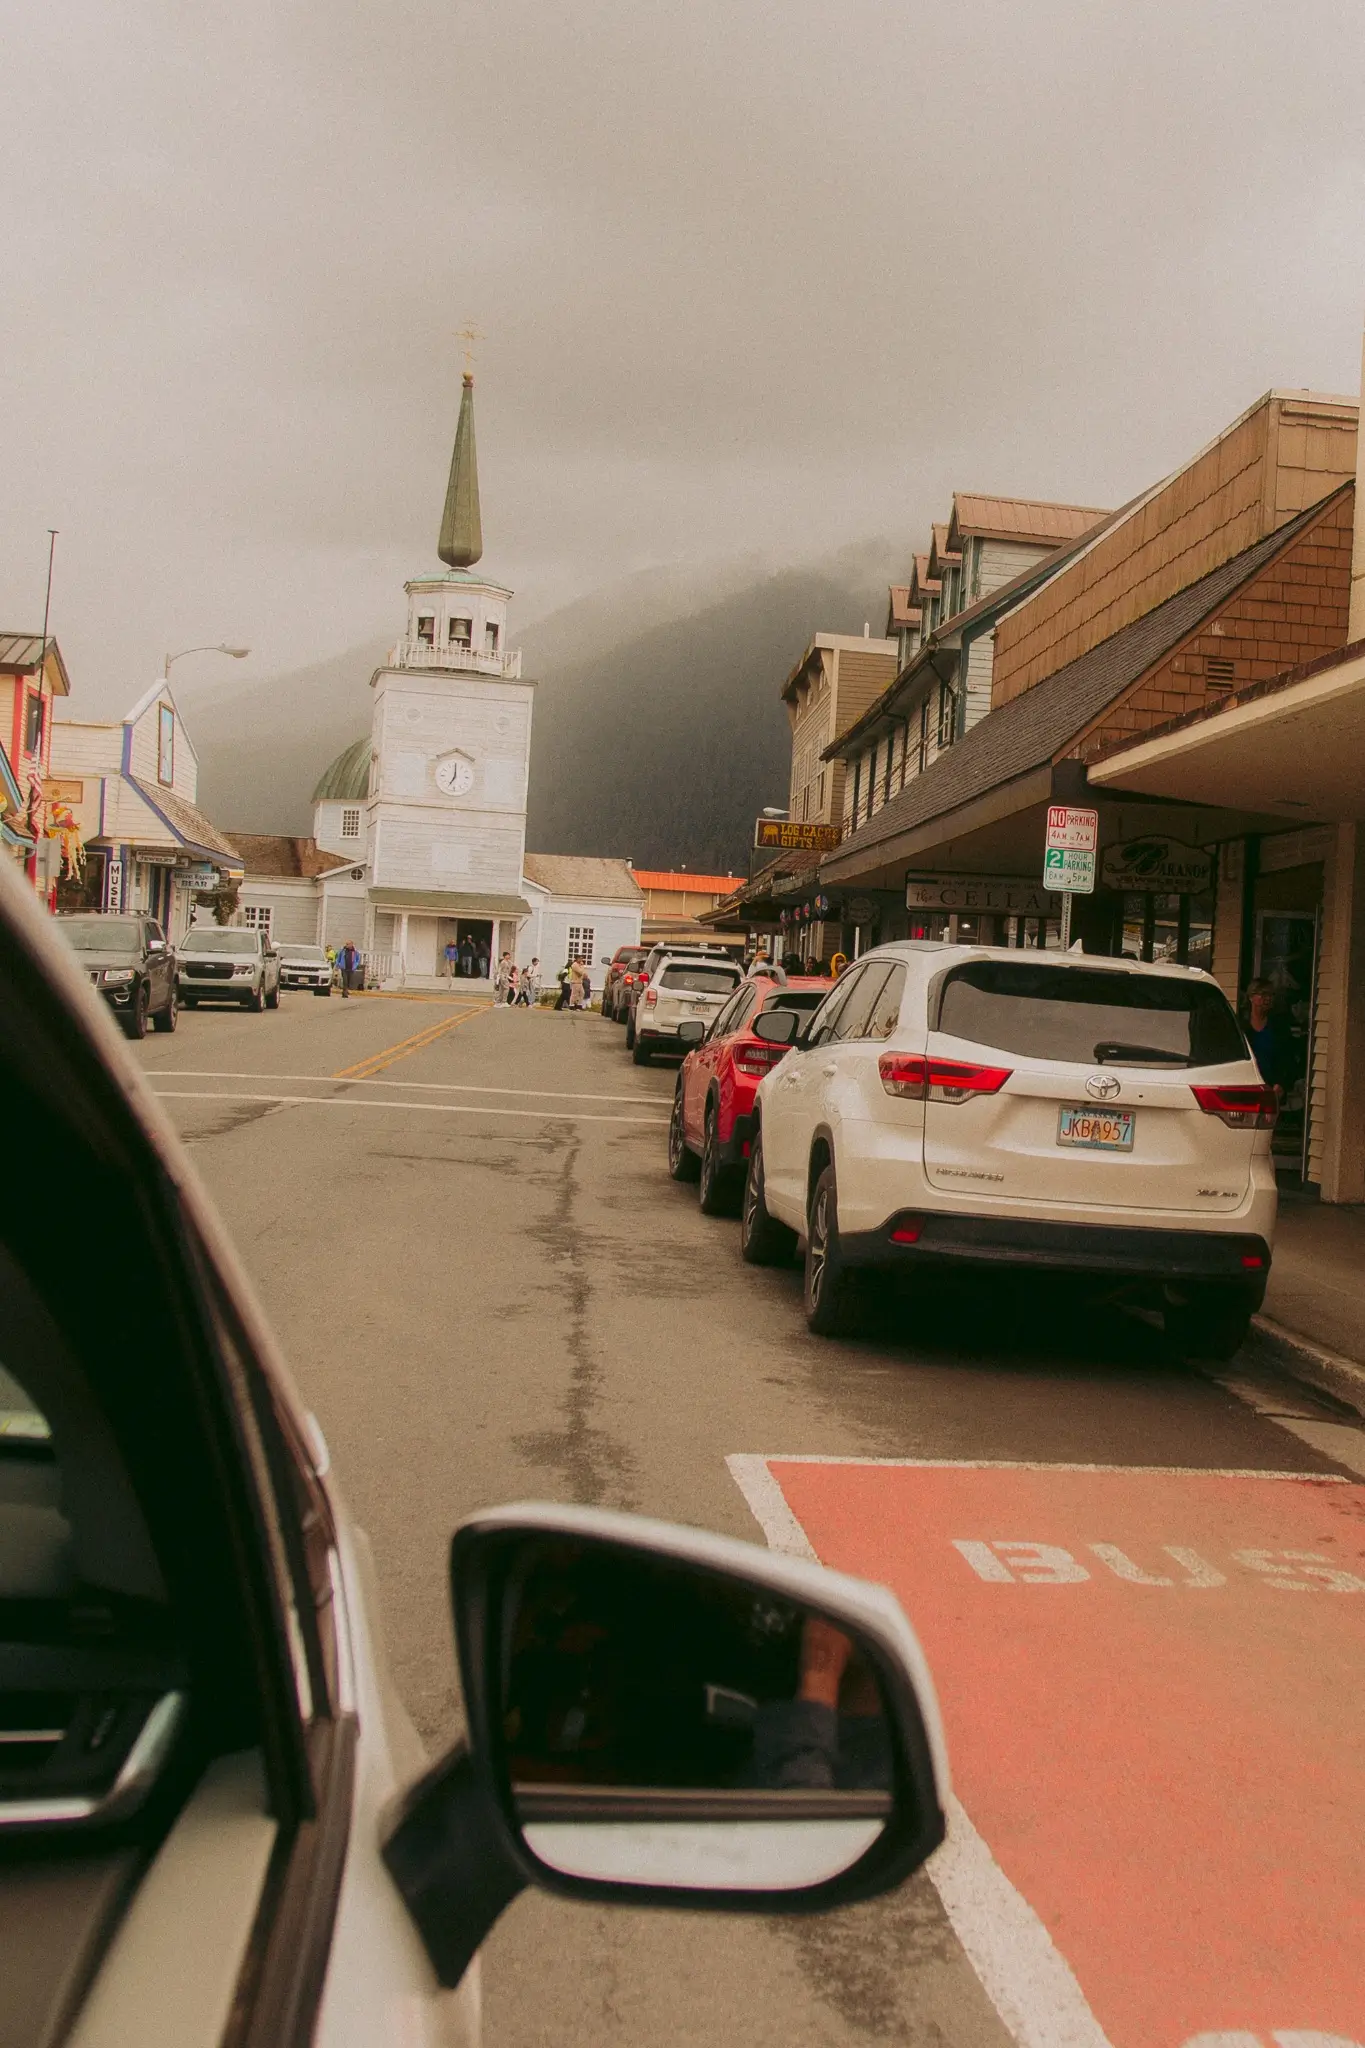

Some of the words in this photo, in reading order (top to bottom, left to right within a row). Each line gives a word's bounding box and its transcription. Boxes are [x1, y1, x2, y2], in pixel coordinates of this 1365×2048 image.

[1050, 810, 1065, 827] NO
[1066, 814, 1095, 827] PARKING
[780, 823, 800, 836] LOG
[780, 835, 813, 850] GIFTS
[1049, 850, 1061, 867] 2
[1068, 852, 1088, 861] HOUR
[1063, 860, 1092, 872] PARKING
[110, 865, 120, 914] MUSE
[940, 889, 1063, 910] CELLAR
[1062, 1117, 1091, 1138] JKB
[1103, 1120, 1131, 1141] 957
[951, 1540, 1365, 1592] BUS
